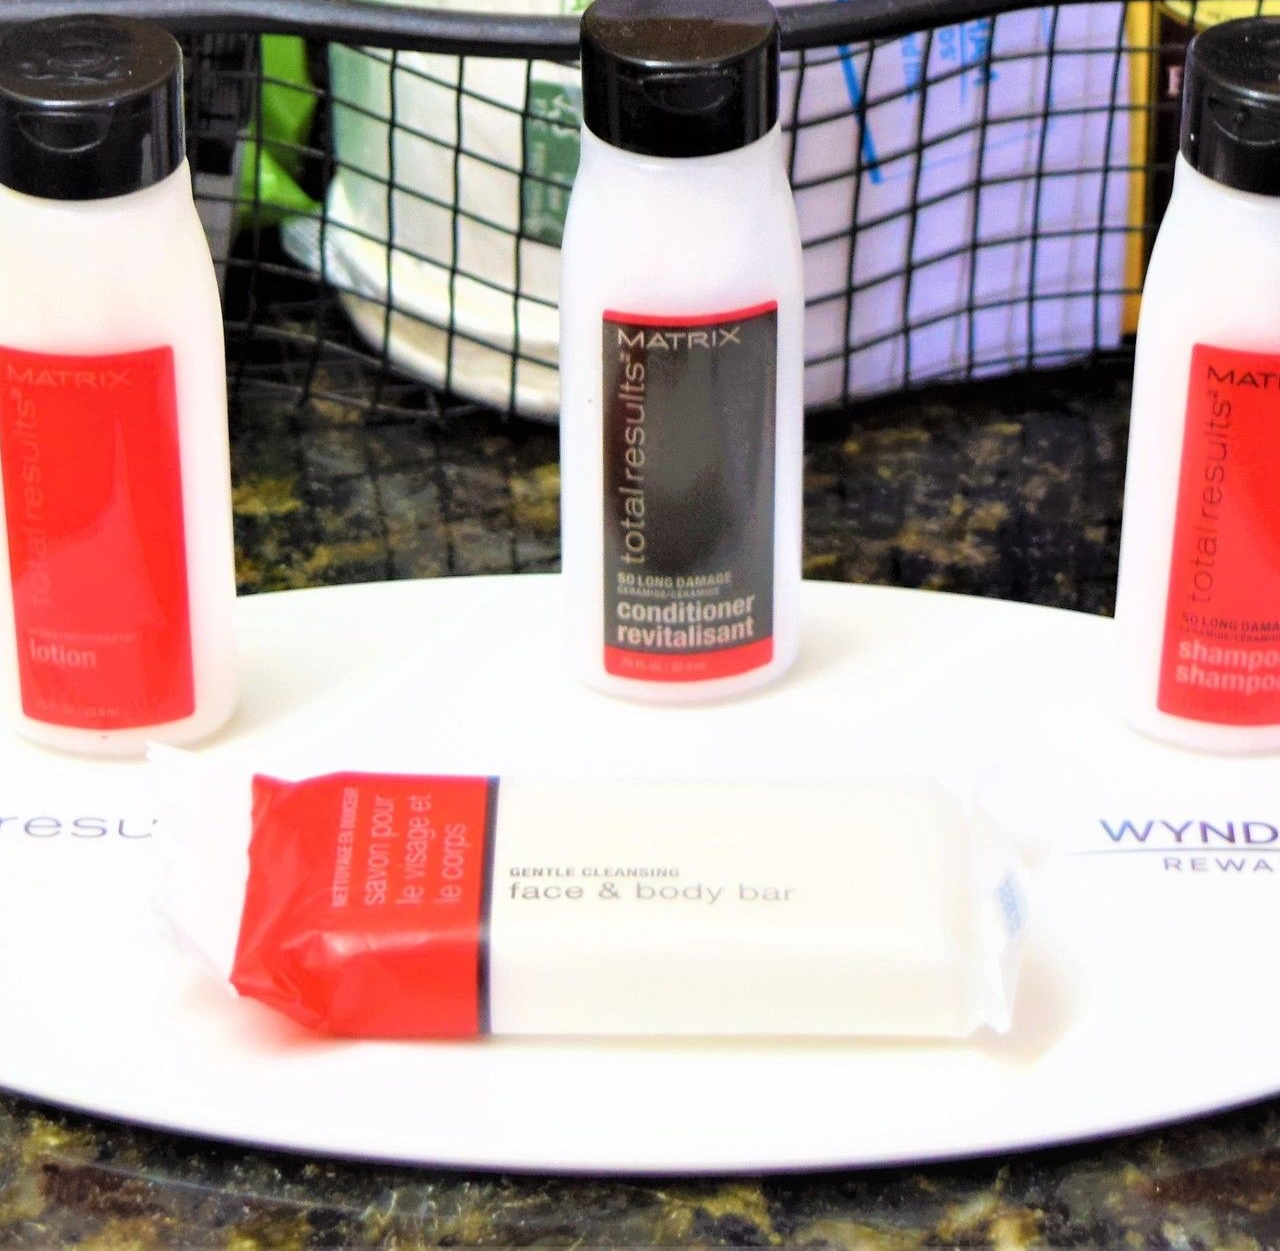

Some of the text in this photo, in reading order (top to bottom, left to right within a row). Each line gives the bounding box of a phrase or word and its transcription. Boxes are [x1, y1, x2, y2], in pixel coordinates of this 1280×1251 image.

[618, 328, 741, 350] MATRIX
[616, 594, 756, 623] conditioner
[617, 616, 754, 648] revitalisant
[29, 636, 97, 669] lotion
[365, 795, 398, 905] savon pour
[396, 793, 436, 904] le visage et
[433, 824, 472, 903] le corps
[510, 867, 680, 878] GENTLE CLEANSING
[509, 881, 797, 905] face & body bar
